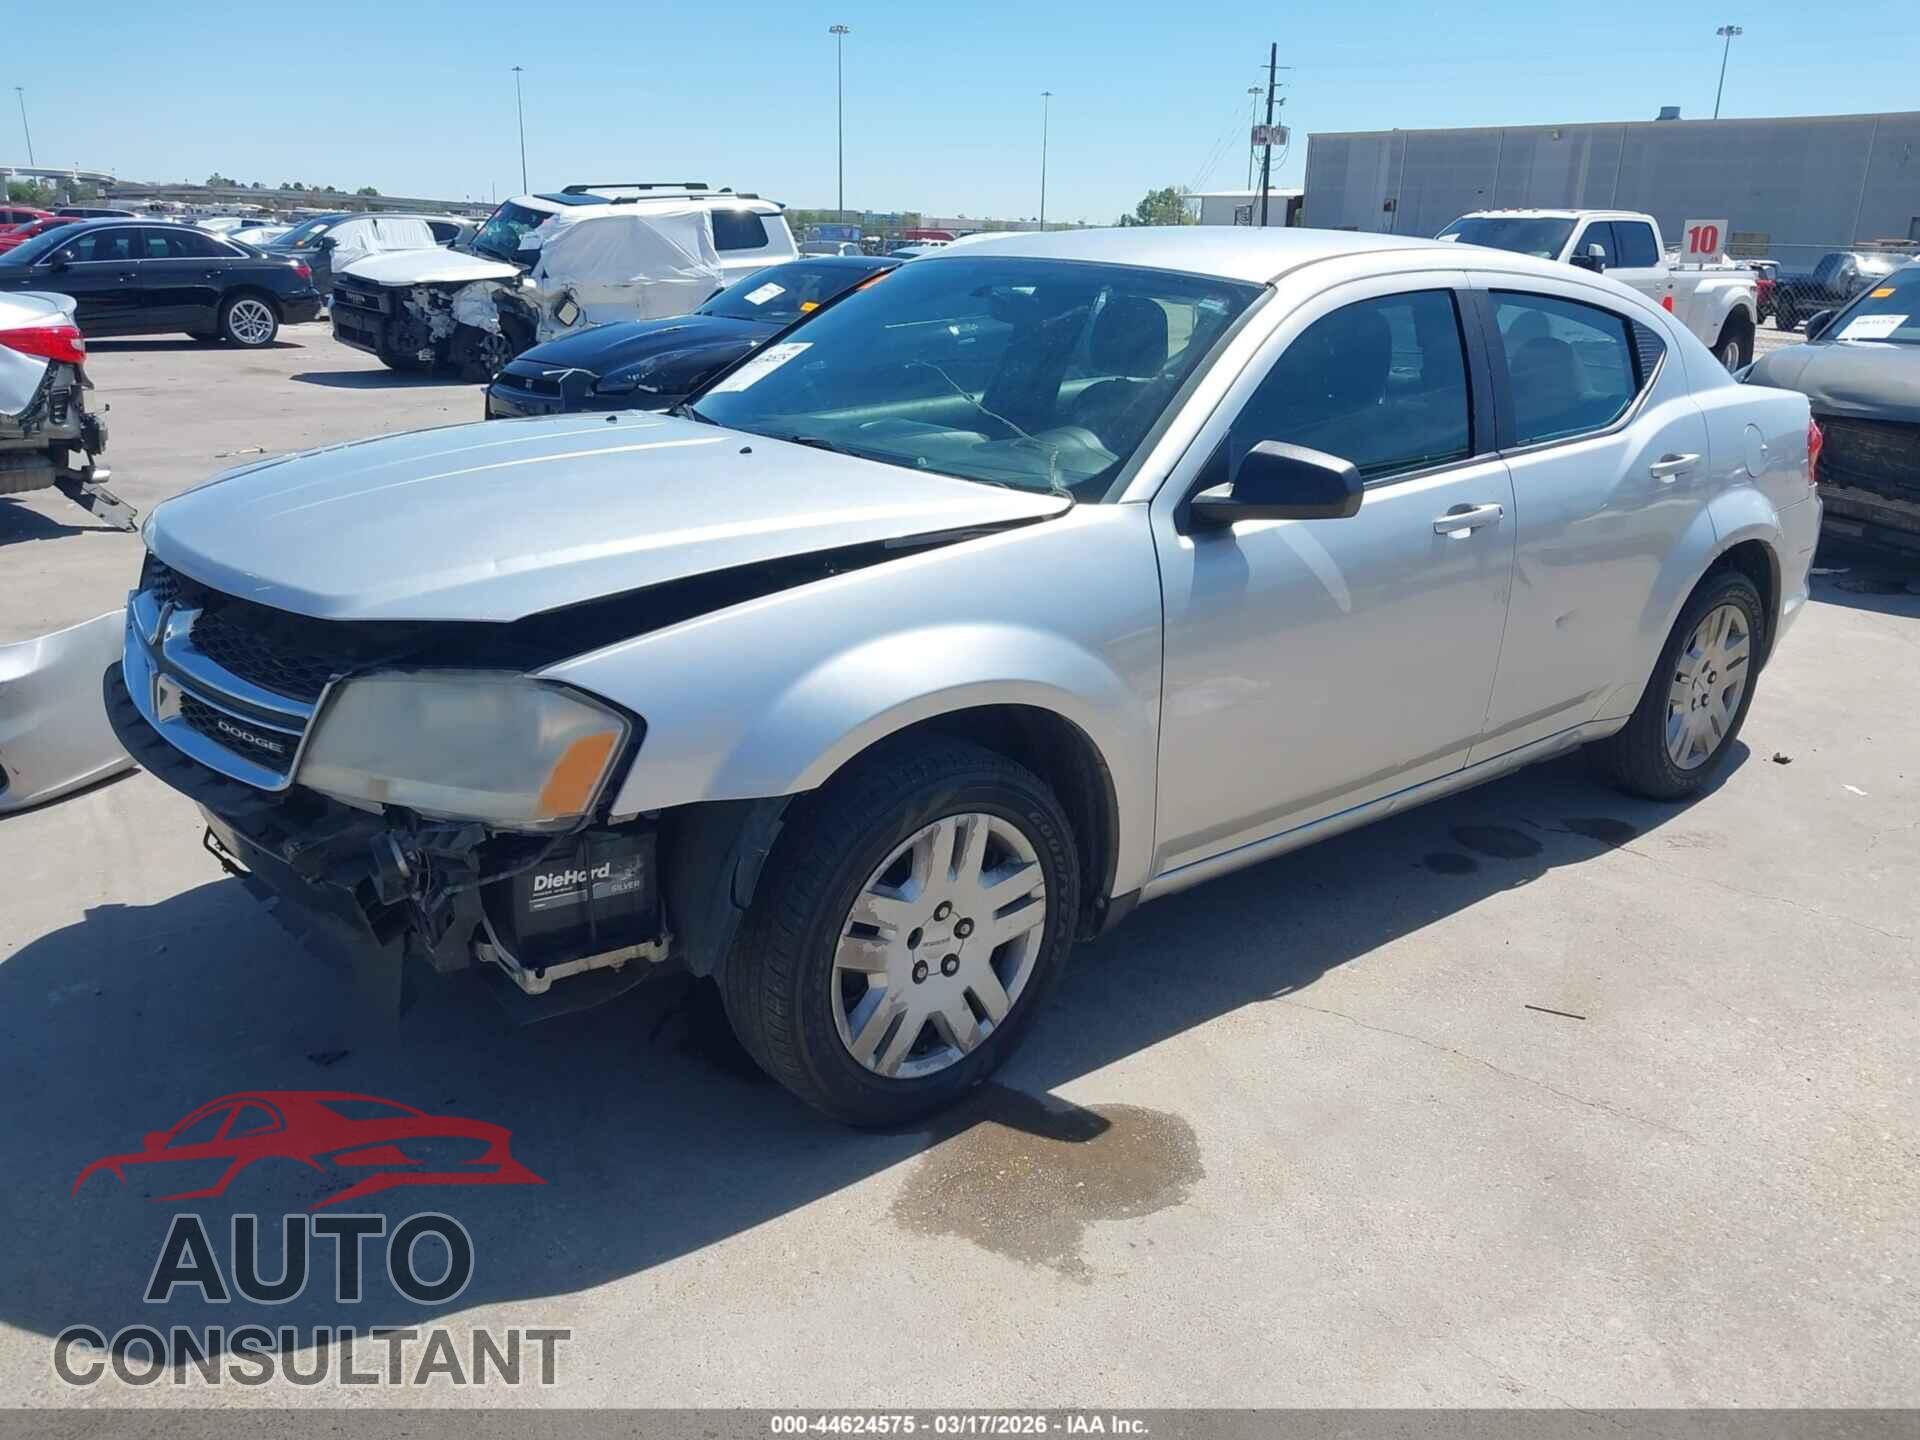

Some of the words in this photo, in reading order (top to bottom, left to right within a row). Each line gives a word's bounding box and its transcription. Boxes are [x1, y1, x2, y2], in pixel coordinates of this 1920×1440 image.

[1688, 225, 1718, 253] 10
[218, 721, 284, 753] DODGE
[533, 862, 611, 892] DieHard
